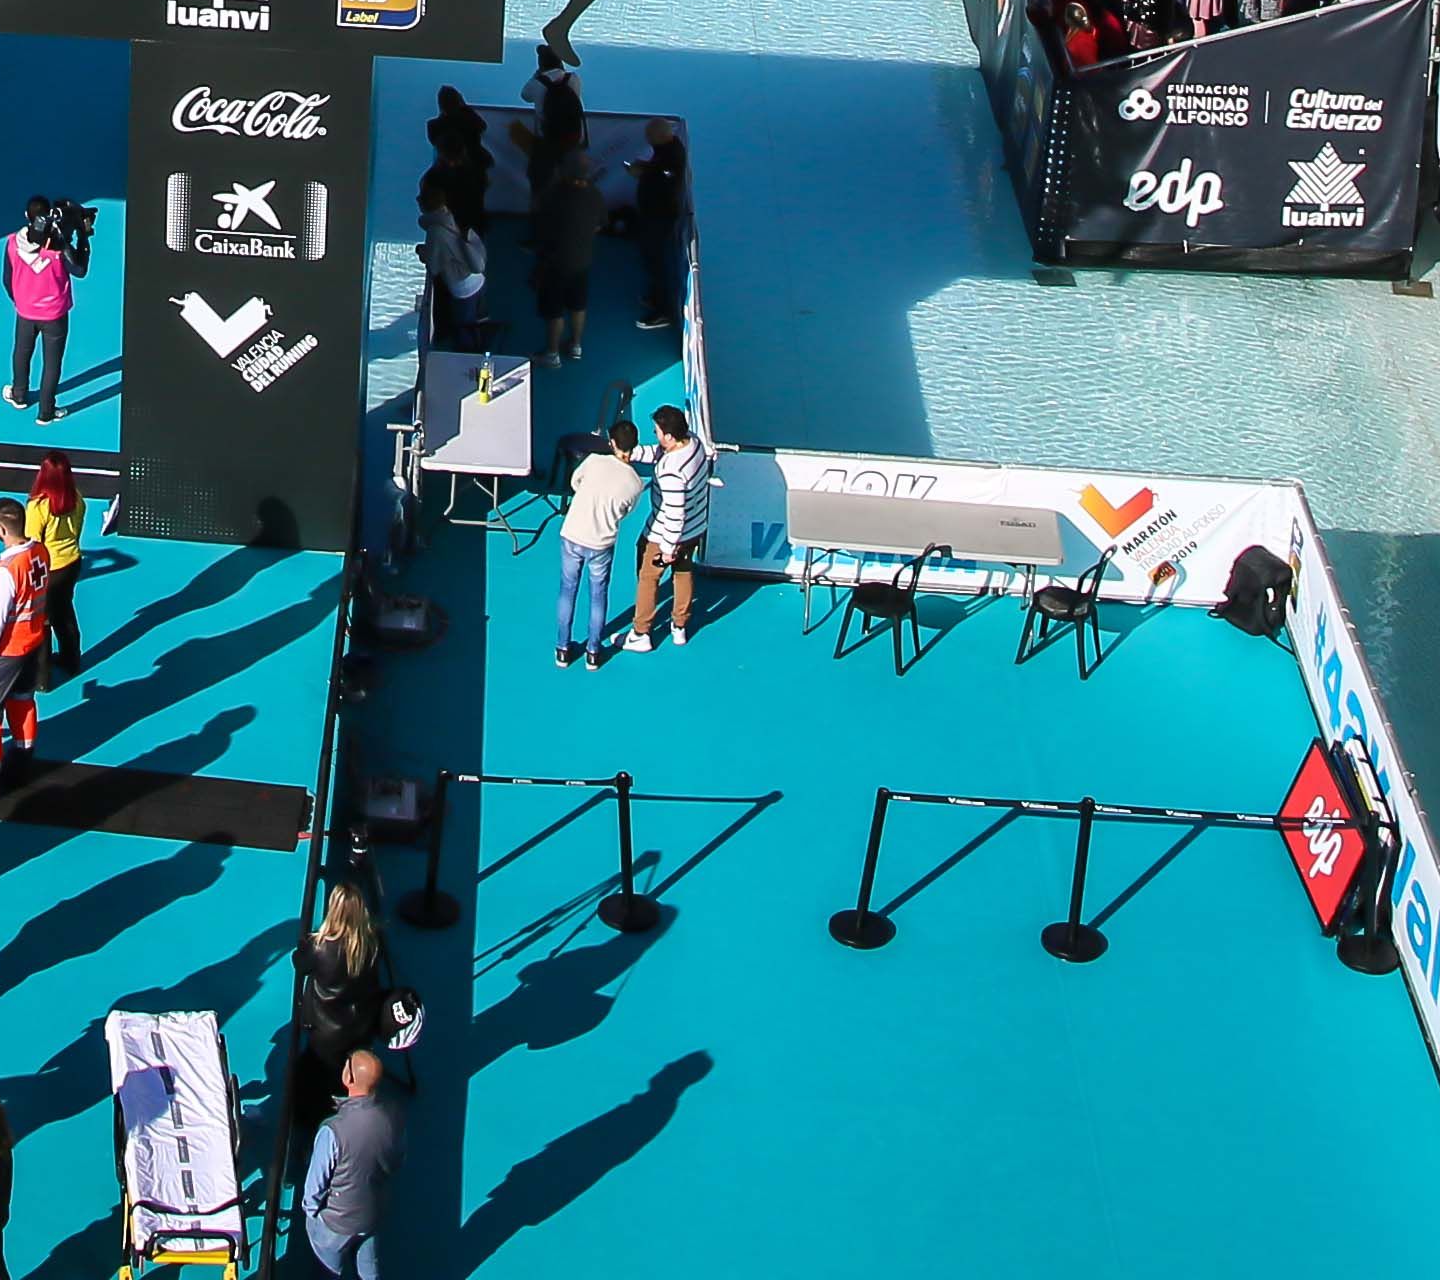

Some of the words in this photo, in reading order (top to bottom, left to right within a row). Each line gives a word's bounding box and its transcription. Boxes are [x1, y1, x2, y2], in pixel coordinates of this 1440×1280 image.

[166, 0, 271, 32] luanvi
[345, 10, 379, 24] Label
[1165, 95, 1250, 112] TRINIDAD
[1166, 84, 1250, 97] FUNDACIÓN
[1290, 88, 1365, 112] Cultura
[1364, 97, 1383, 112] del
[171, 86, 331, 139] Coca-Cola
[1165, 110, 1250, 127] ALFONSO
[1285, 107, 1383, 132] Esfuerzo
[1123, 157, 1224, 226] edp
[1281, 203, 1365, 228] luanvi
[194, 233, 296, 259] CaixaBank
[231, 328, 285, 373] VALENCIA
[241, 343, 285, 384] CIUDAD
[248, 365, 273, 393] DEL
[1121, 508, 1178, 558] MARATÓN
[1181, 503, 1227, 540] ALFONSO
[1131, 524, 1183, 565] VALENCIA
[1173, 540, 1199, 565] 2019
